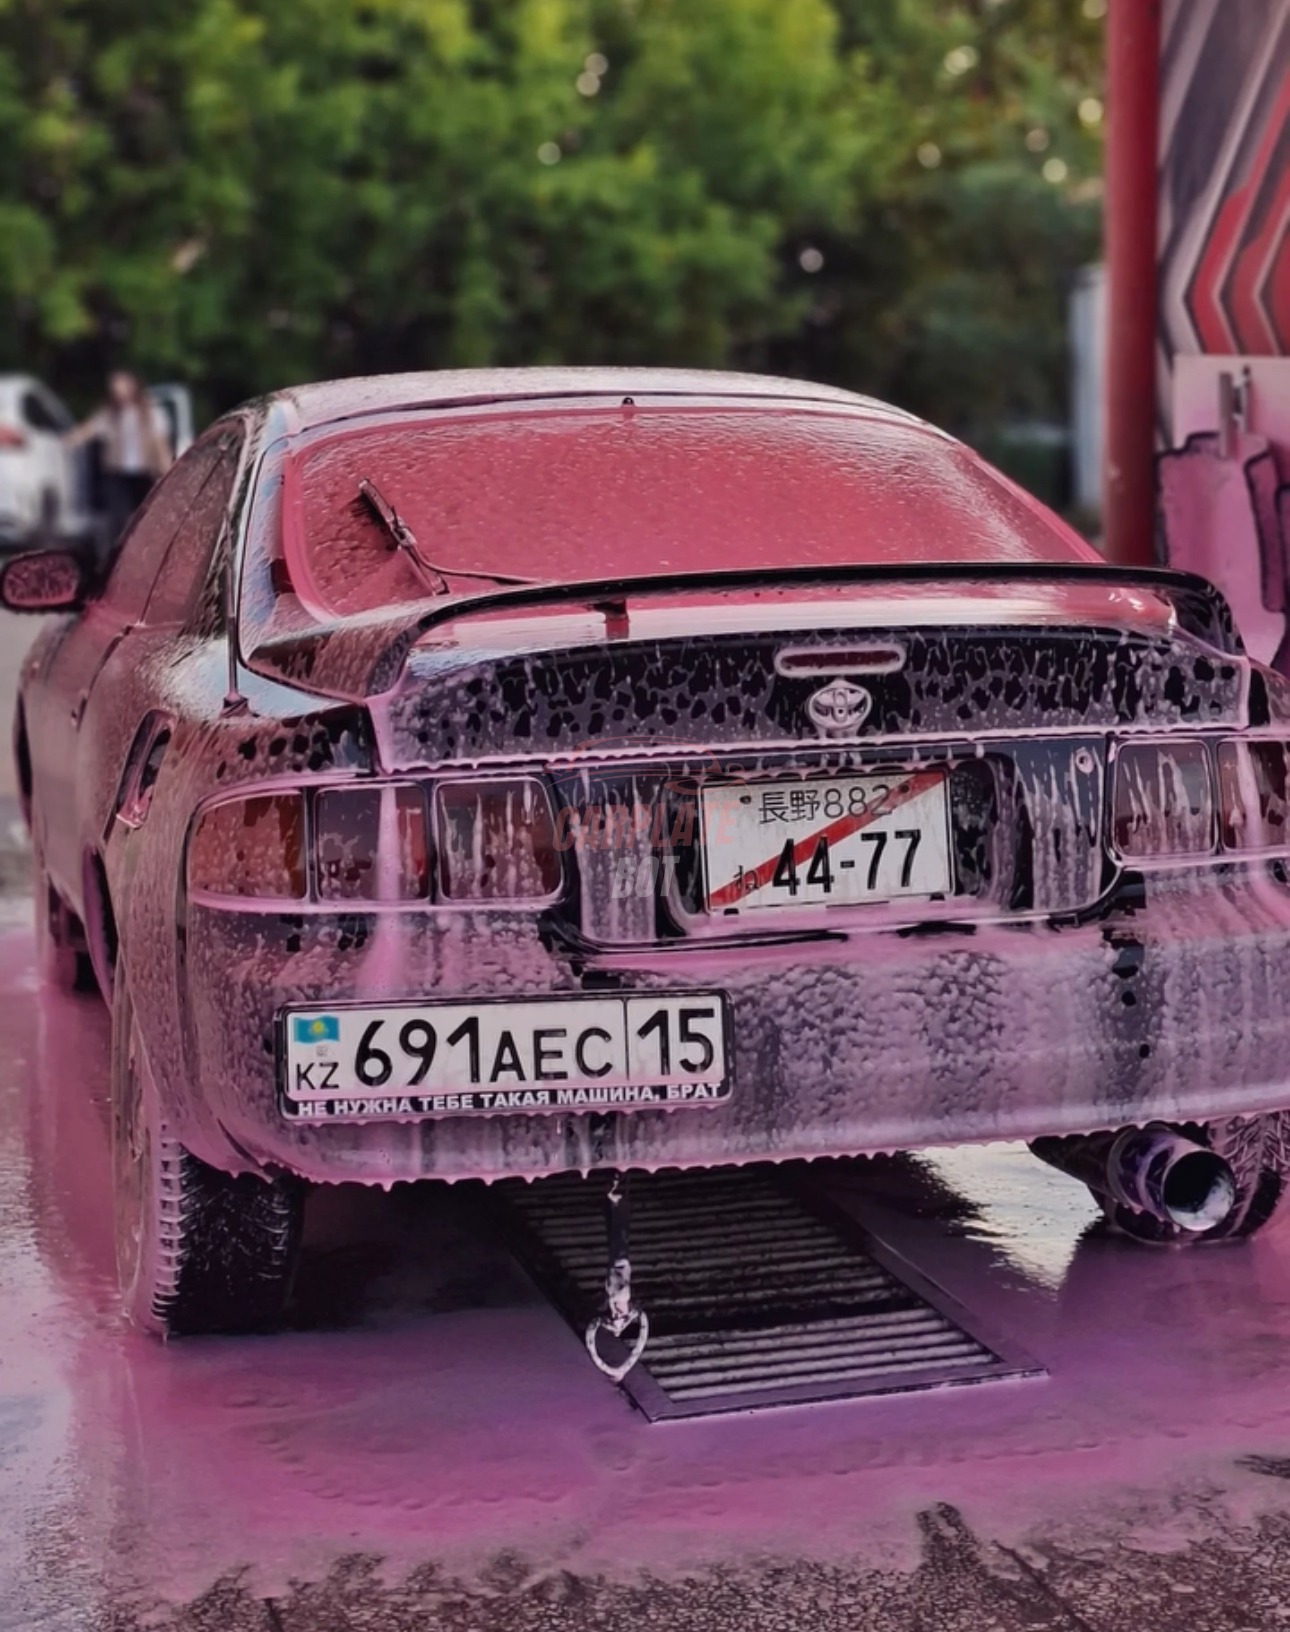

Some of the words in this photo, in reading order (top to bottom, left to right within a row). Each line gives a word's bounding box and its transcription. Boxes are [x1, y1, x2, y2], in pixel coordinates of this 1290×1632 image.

[759, 784, 893, 824] 長野882
[771, 829, 922, 896] 44-77
[296, 1061, 340, 1090] KZ
[637, 1008, 715, 1076] 15
[299, 1101, 327, 1117] НЕ
[334, 1098, 414, 1116] НУЖНА
[419, 1094, 474, 1111] ТЕБЕ
[480, 1090, 550, 1109] ТАКАЯ
[556, 1086, 661, 1105] МАШИНА,
[666, 1082, 722, 1100] БРАТ
